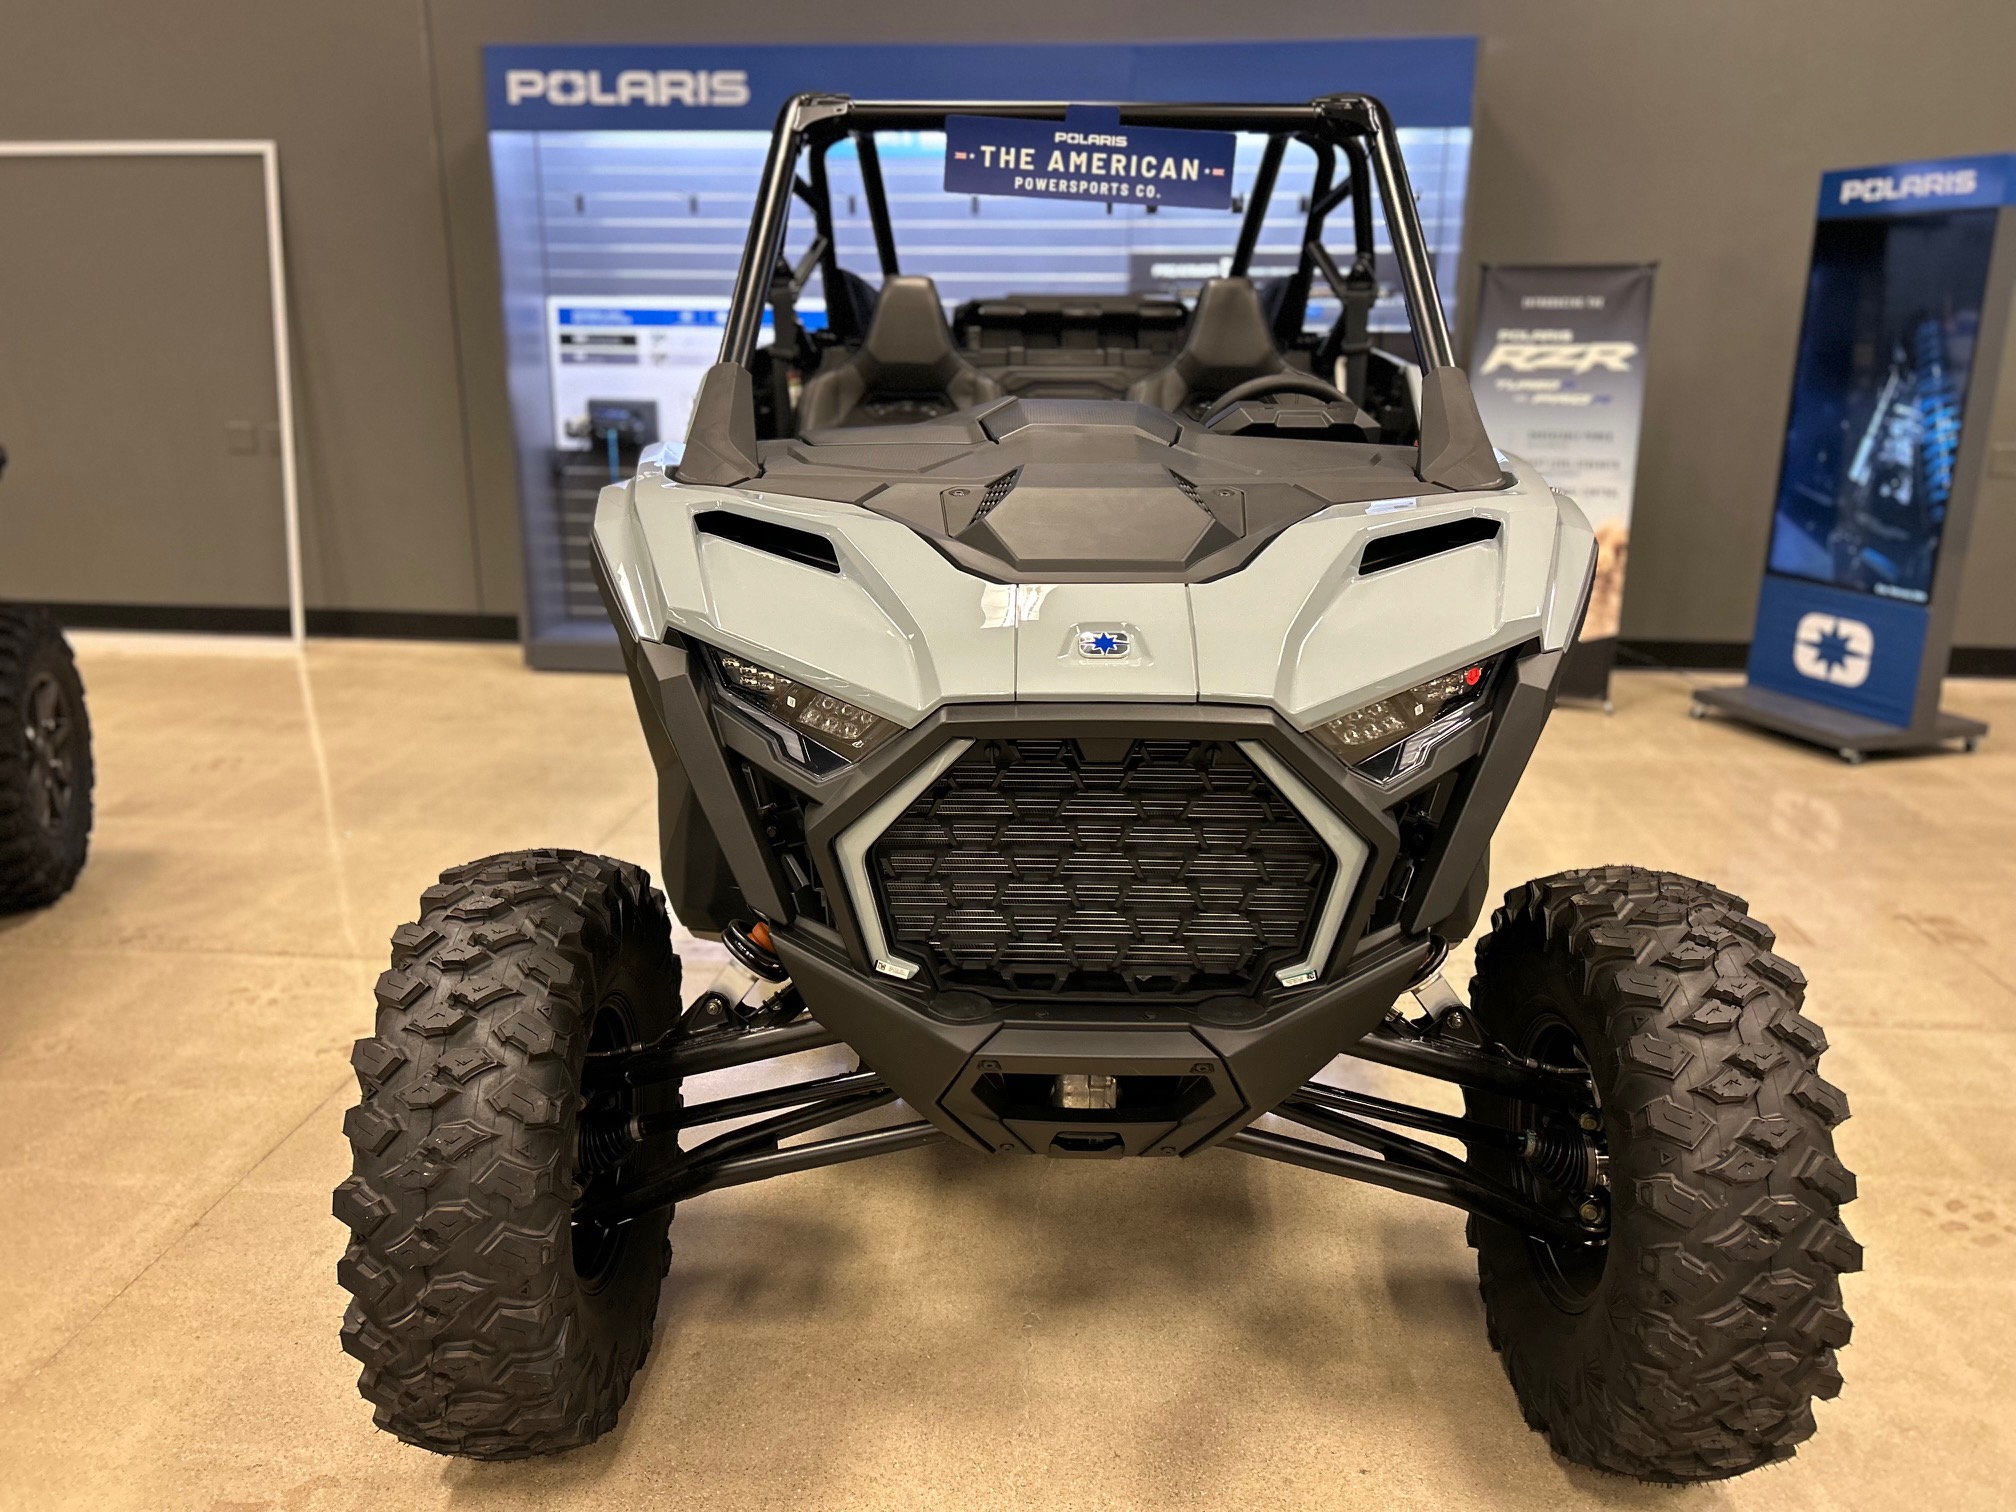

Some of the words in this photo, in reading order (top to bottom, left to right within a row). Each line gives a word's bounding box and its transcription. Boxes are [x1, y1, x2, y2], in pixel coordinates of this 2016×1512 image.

[505, 69, 751, 107] POLARIS
[1053, 131, 1129, 147] POLARIS
[980, 144, 1036, 171] THE
[1046, 150, 1200, 181] AMERICAN
[1014, 176, 1130, 197] POWERSPORTS
[1135, 184, 1162, 199] CO.
[1839, 169, 1978, 206] POLARIS
[1480, 341, 1639, 375] RZR
